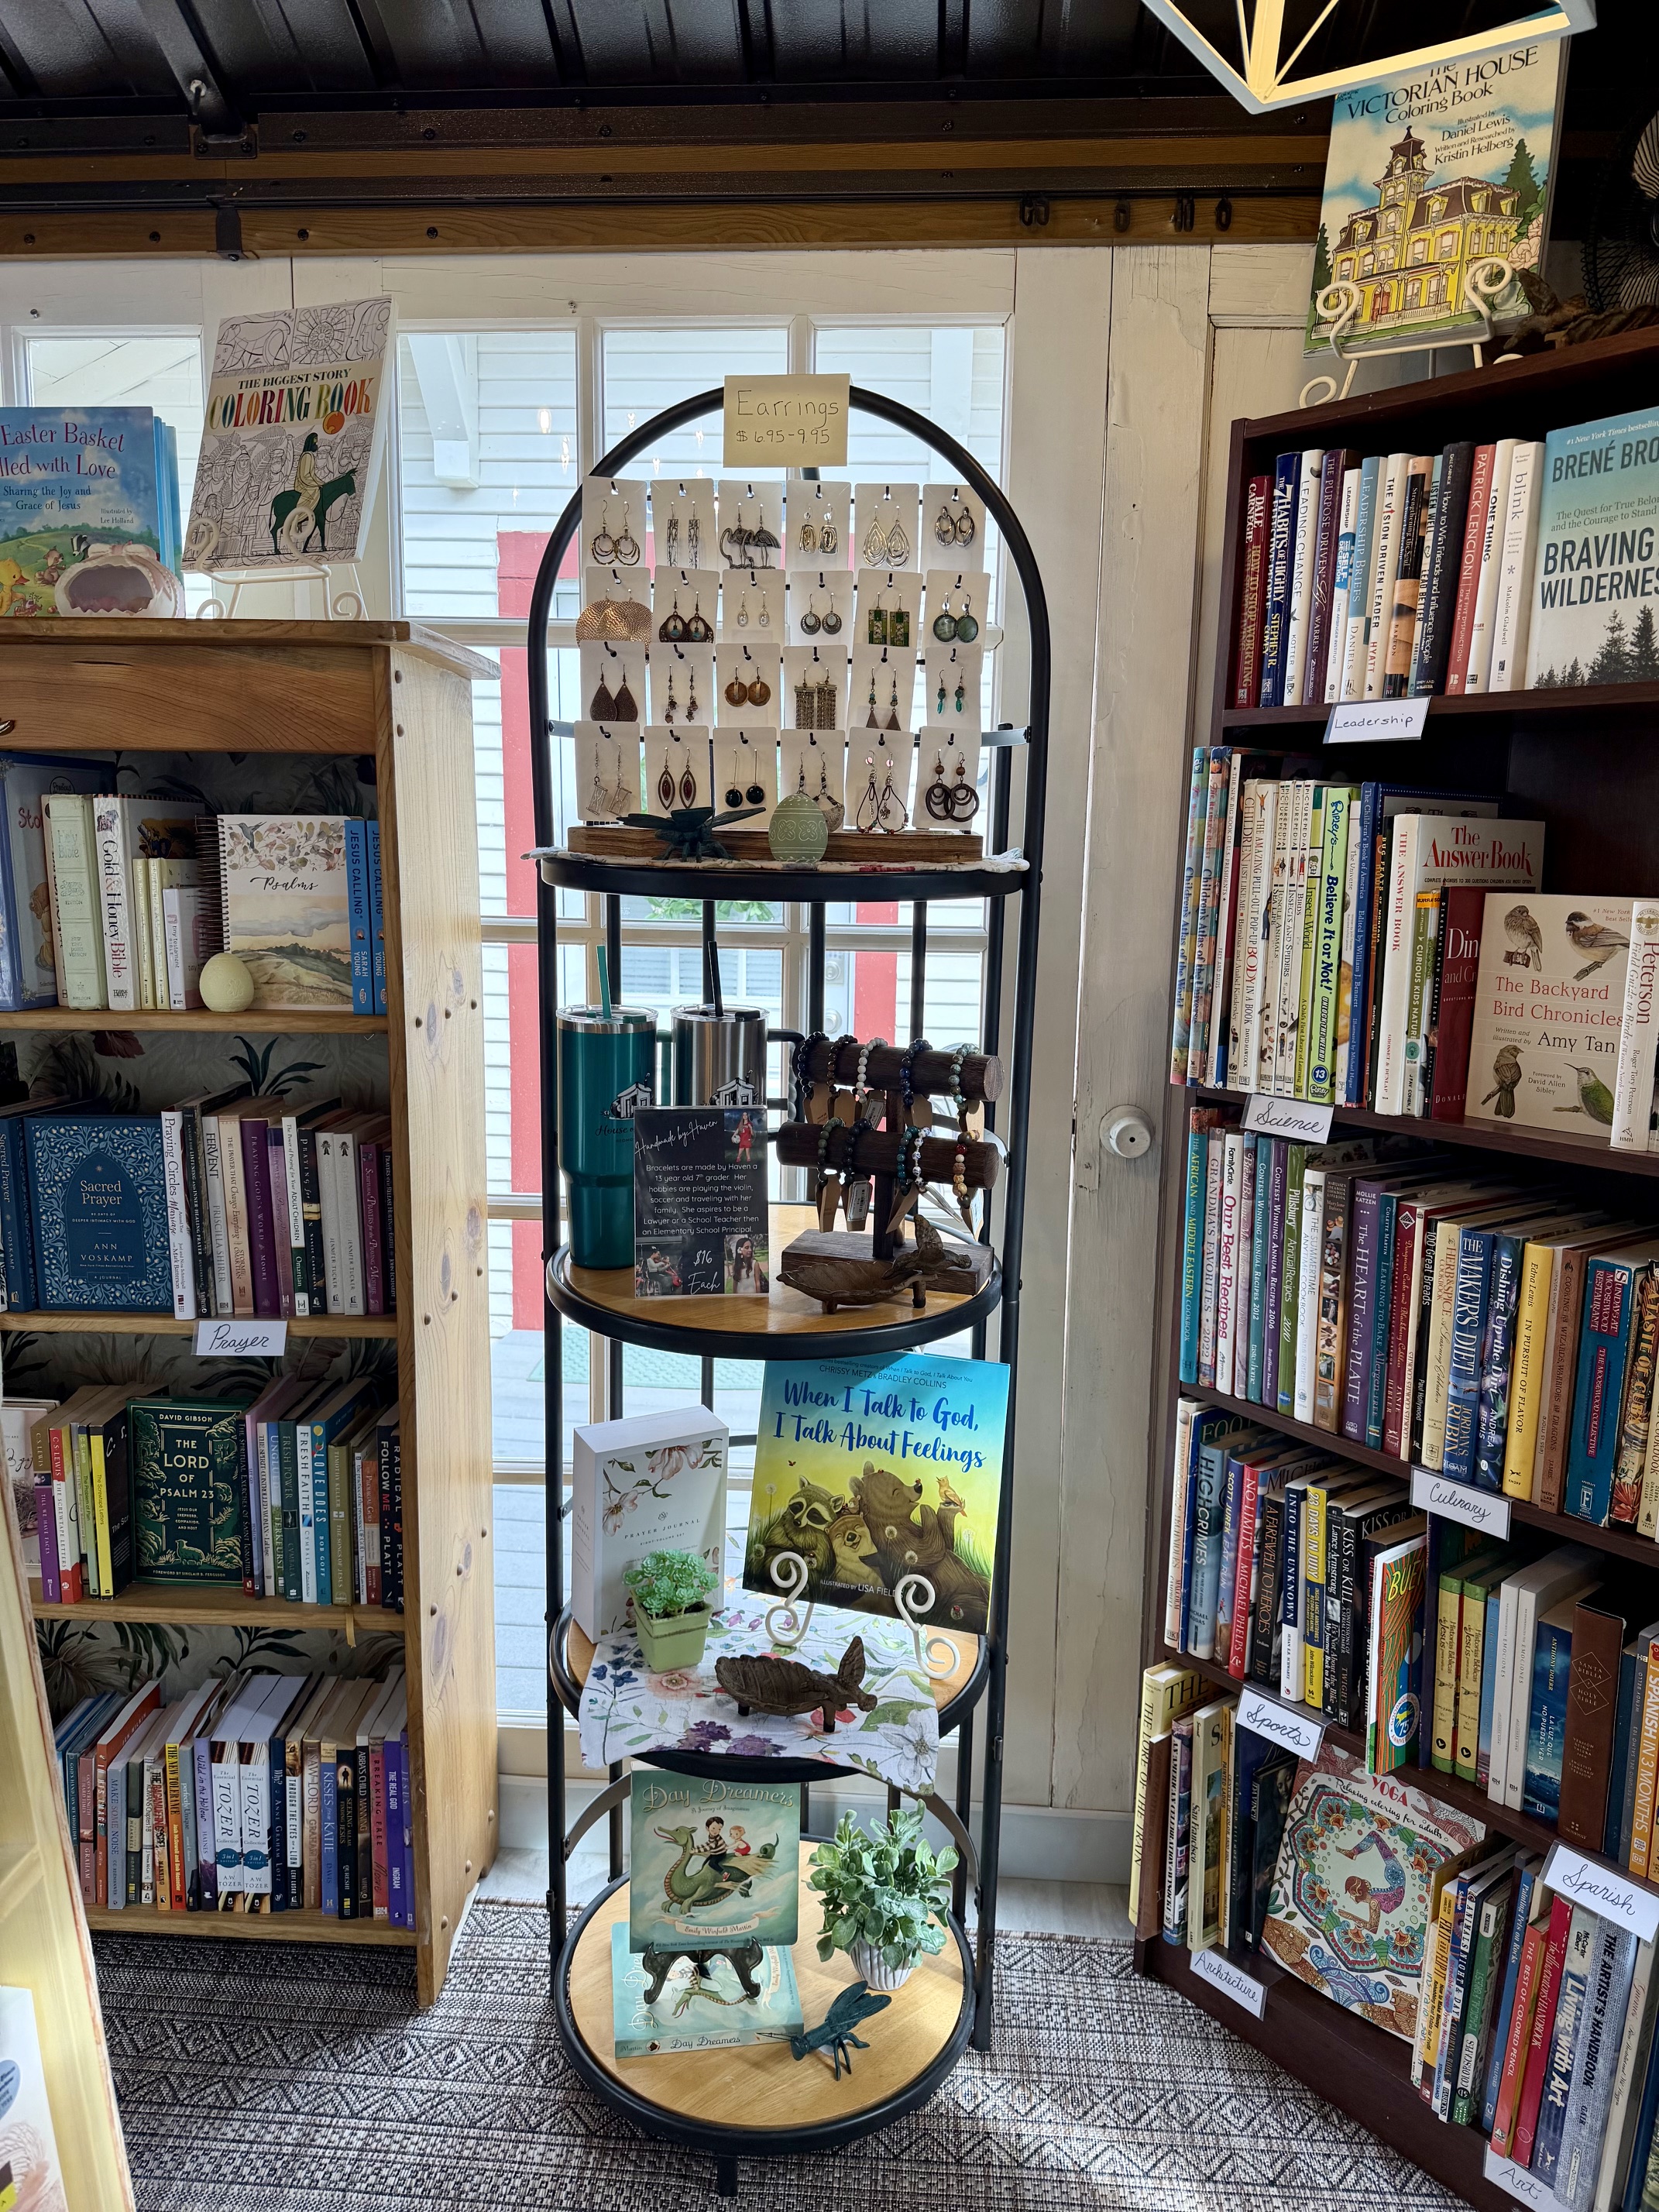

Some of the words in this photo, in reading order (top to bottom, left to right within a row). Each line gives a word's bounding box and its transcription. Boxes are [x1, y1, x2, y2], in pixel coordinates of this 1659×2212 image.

[1348, 70, 1458, 119] VICTORIAN
[1465, 46, 1539, 86] HOUSE
[1385, 96, 1448, 124] Coloring
[1451, 81, 1494, 106] Book
[1442, 122, 1476, 141] Daniel
[1478, 115, 1510, 132] Lewis
[1434, 149, 1468, 165] Kristin
[1471, 136, 1514, 156] Helberg
[239, 379, 260, 390] THE
[263, 373, 311, 387] BIGGEST
[312, 369, 352, 382] STORY
[209, 386, 311, 430] COLORING
[314, 377, 375, 420] BOOK
[737, 390, 839, 429] Earrings
[0, 424, 57, 446] Easter
[64, 422, 125, 452] Basket
[36, 456, 70, 472] with
[76, 454, 116, 479] Love
[1552, 439, 1616, 483] BRENÉ
[3, 486, 39, 498] Sharing
[42, 486, 56, 496] the
[60, 486, 72, 498] Joy
[75, 486, 91, 496] and
[1385, 477, 1395, 497] THE
[1469, 453, 1488, 510] PATRICK
[1510, 472, 1528, 521] blink
[15, 500, 43, 510] Grace
[45, 501, 54, 510] of
[58, 500, 81, 512] Jesus
[1296, 480, 1310, 539] LEADING
[1551, 521, 1566, 532] and
[1568, 519, 1582, 528] the
[1583, 514, 1619, 526] Courage
[1620, 511, 1630, 520] to
[1631, 506, 1657, 518] Stand
[1556, 510, 1572, 520] The
[1573, 507, 1598, 518] Quest
[1600, 503, 1613, 513] for
[1614, 500, 1635, 510] True
[1462, 513, 1479, 583] LENCIONI
[1544, 527, 1654, 575] BRAVING
[1293, 543, 1306, 598] CHANGE
[1377, 545, 1389, 586] DRIVEN
[1372, 589, 1383, 629] LEADER
[1366, 641, 1378, 673] HYATT
[1334, 713, 1413, 733] Leadership
[350, 830, 360, 865] JESUS
[1451, 825, 1480, 846] The
[102, 840, 119, 877] Gold
[1422, 837, 1489, 869] Answer
[1488, 840, 1537, 877] Book
[106, 878, 119, 891] &
[250, 876, 318, 891] Psalms
[105, 893, 122, 942] Honey
[110, 942, 128, 978] Bible
[1495, 976, 1523, 993] The
[1530, 979, 1609, 1001] Backyard
[1493, 1001, 1524, 1017] Bird
[1530, 1004, 1623, 1027] Chronicles
[1537, 1031, 1578, 1052] Amy
[1585, 1036, 1616, 1053] Tan
[1255, 1101, 1324, 1134] Science
[206, 1132, 219, 1179] FERVENT
[634, 1130, 676, 1160] Handmade
[677, 1126, 688, 1147] by
[685, 1119, 718, 1140] Haven
[705, 1174, 730, 1183] grader.
[717, 1163, 726, 1172] by
[81, 1180, 122, 1193] Sacred
[82, 1193, 122, 1208] Prayer
[1223, 1195, 1236, 1229] Our
[1286, 1188, 1300, 1225] Pillsbury
[1358, 1224, 1369, 1245] The
[693, 1249, 713, 1267] $16
[1221, 1233, 1235, 1270] Best
[688, 1271, 720, 1295] Each
[1354, 1245, 1369, 1315] HEART
[1218, 1276, 1232, 1339] Recipes
[1354, 1313, 1363, 1327] of
[209, 1324, 270, 1351] Prayer
[1352, 1328, 1362, 1346] the
[819, 1365, 850, 1377] CHRISSY
[851, 1368, 872, 1379] METZ
[878, 1372, 912, 1384] BRADLEY
[913, 1377, 947, 1389] COLLINS
[1347, 1348, 1362, 1404] PLATE
[784, 1379, 840, 1407] When
[841, 1386, 855, 1413] I
[859, 1389, 907, 1418] Talk
[909, 1397, 928, 1423] to
[933, 1396, 979, 1431] God,
[175, 1440, 198, 1449] THE
[773, 1411, 786, 1438] I
[790, 1414, 837, 1444] Talk
[840, 1421, 900, 1455] About
[901, 1430, 987, 1473] Feelings
[163, 1453, 210, 1469] LORD
[381, 1441, 390, 1490] FOLLOW
[160, 1488, 198, 1499] PSALM
[201, 1490, 215, 1499] 23
[179, 1474, 194, 1483] OF
[382, 1494, 390, 1510] ME
[1430, 1480, 1491, 1522] Culinary
[624, 1528, 658, 1540] PRAYER
[662, 1518, 700, 1531] JOURNAL
[1287, 1528, 1297, 1554] THE
[1286, 1558, 1295, 1620] UNKNOWN
[1246, 1704, 1310, 1747] Sports
[642, 1782, 691, 1812] Day
[699, 1779, 794, 1808] Dreamers
[1372, 1775, 1408, 1807] YOGA
[217, 1783, 233, 1837] TOZER
[242, 1784, 260, 1839] TOZER
[1335, 1777, 1368, 1803] Relaxing
[1370, 1799, 1401, 1821] coloring
[1403, 1814, 1416, 1826] for
[1419, 1823, 1442, 1839] adults
[392, 1867, 401, 1890] INGRAM
[1562, 1863, 1636, 1915] Spanish
[684, 1925, 701, 1936] Emily
[702, 1925, 729, 1935] Winfield
[729, 1924, 752, 1933] Martin
[1194, 1952, 1260, 2004] Architecture
[1557, 1977, 1586, 2034] Living
[670, 2038, 693, 2049] Day
[697, 2035, 740, 2047] Dreamers
[1552, 2029, 1578, 2073] with
[1548, 2073, 1568, 2108] Art
[1498, 2168, 1542, 2200] Art
